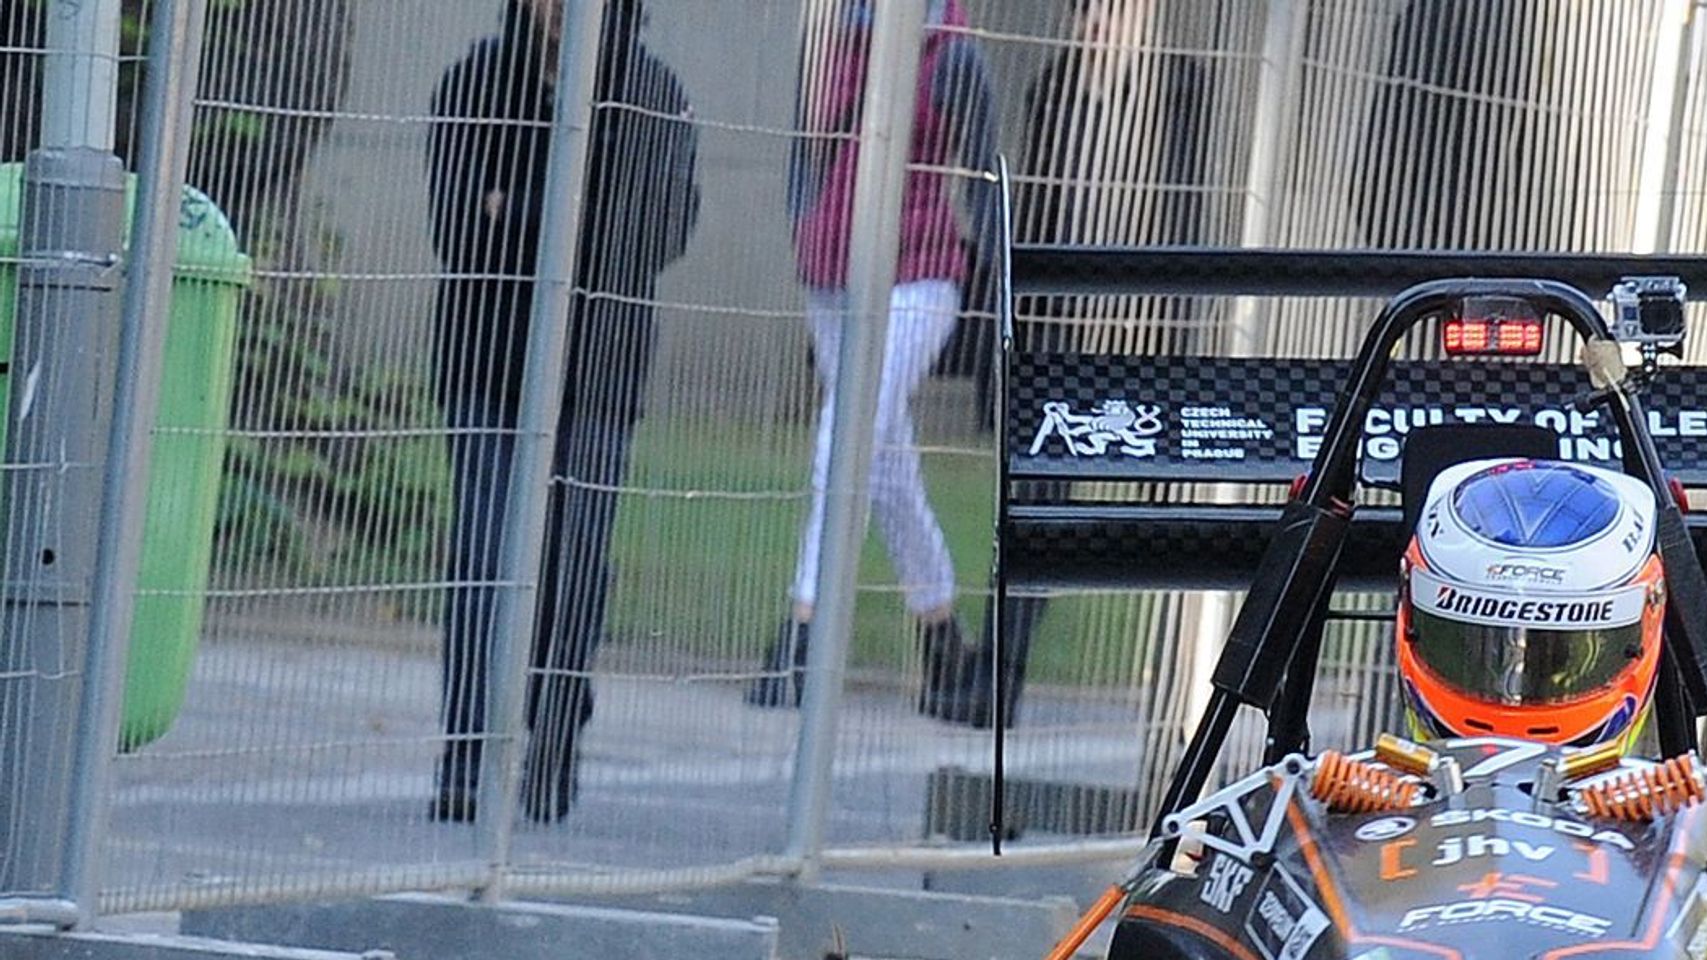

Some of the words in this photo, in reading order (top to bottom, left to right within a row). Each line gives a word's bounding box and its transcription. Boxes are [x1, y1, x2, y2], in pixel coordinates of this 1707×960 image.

[1181, 407, 1231, 417] CZECH
[1181, 418, 1267, 429] TECHNICAL
[1296, 408, 1522, 434] FCUTY
[1181, 429, 1274, 440] UNIVERSITY
[1182, 448, 1245, 459] PRAGUE
[1436, 586, 1614, 623] BRIDGESTONE
[1431, 833, 1556, 866] jhv
[1200, 852, 1255, 914] SKF
[1400, 899, 1613, 935] FORCE
